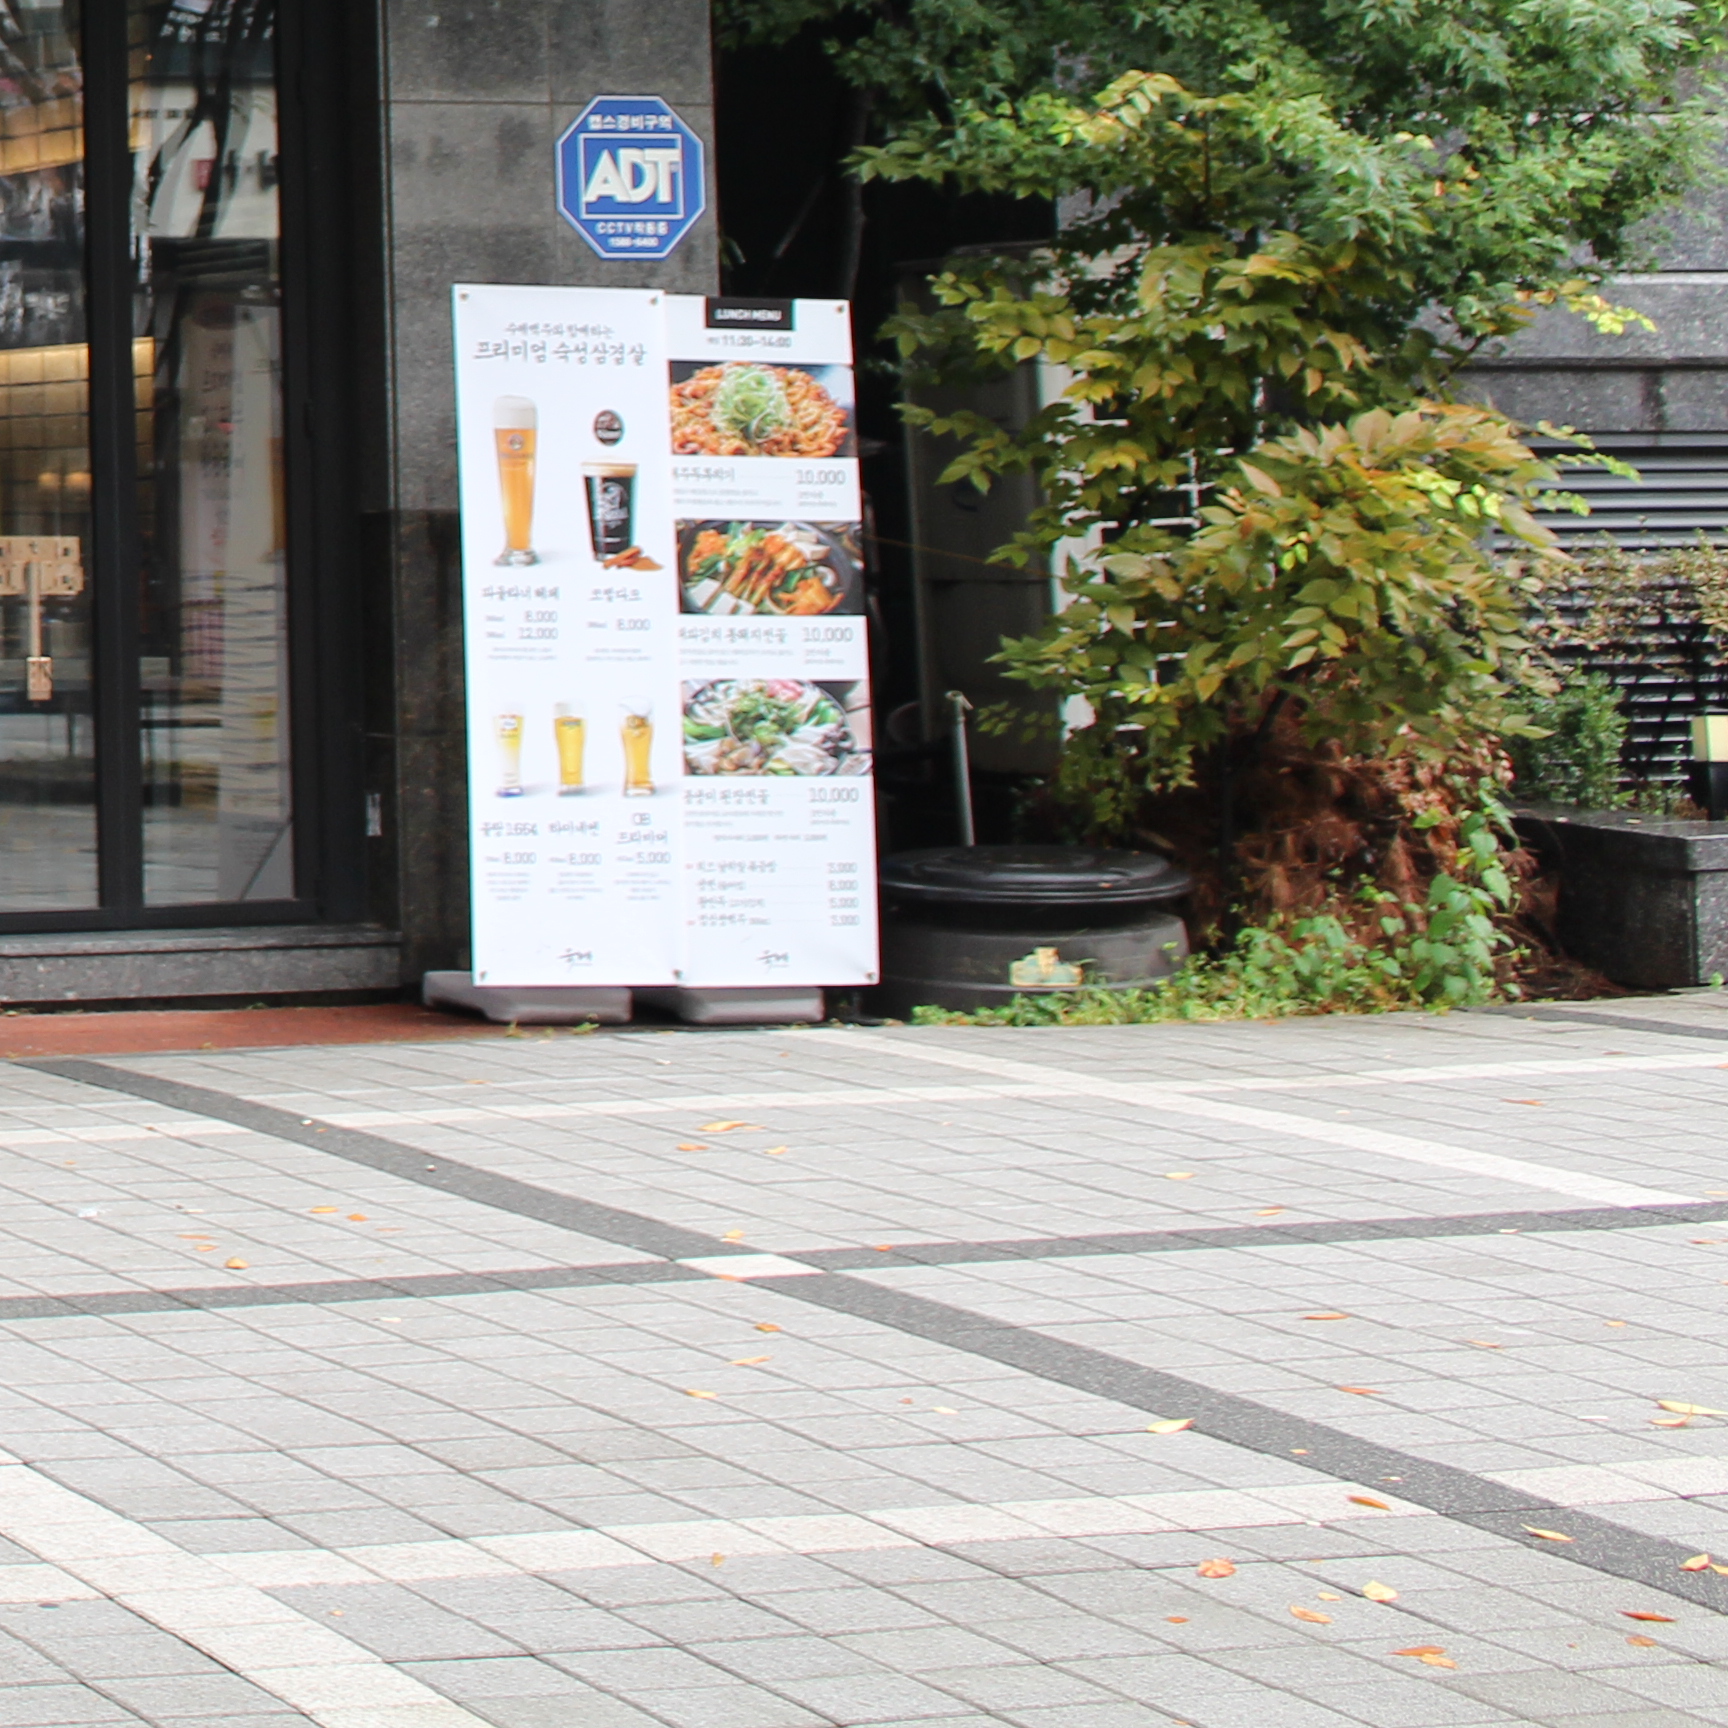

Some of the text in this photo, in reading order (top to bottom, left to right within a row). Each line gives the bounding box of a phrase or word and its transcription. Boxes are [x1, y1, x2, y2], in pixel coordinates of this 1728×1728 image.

[582, 147, 681, 204] ADT
[714, 308, 783, 322] LUNCH MENU
[472, 338, 647, 367] 프리미엄 숙성삼겹살
